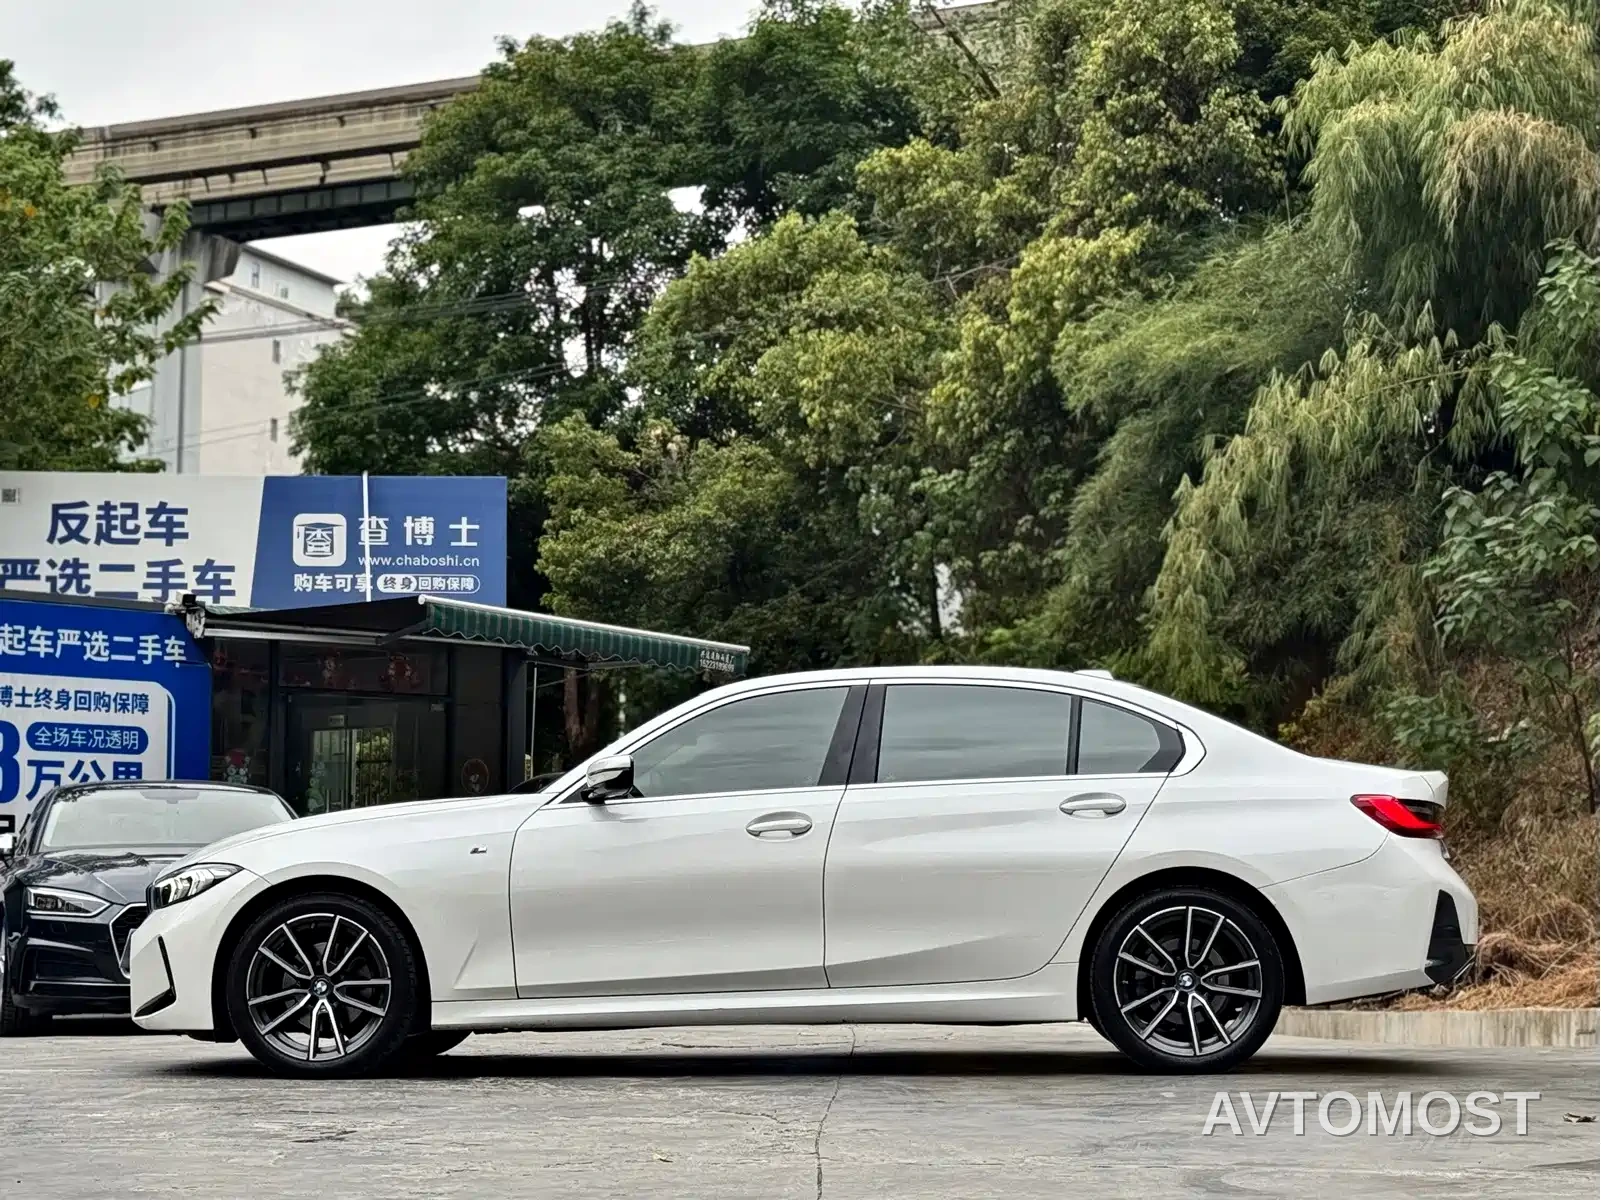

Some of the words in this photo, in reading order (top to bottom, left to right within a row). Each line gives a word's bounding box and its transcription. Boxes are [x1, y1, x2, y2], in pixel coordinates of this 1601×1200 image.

[46, 500, 189, 547] 反起车
[358, 515, 480, 547] 查博士
[358, 554, 480, 567] www.chaboshi.cn
[0, 557, 236, 605] 严选二手车
[0, 622, 187, 668] 起车严选二手车
[34, 726, 139, 750] 全场车况透明
